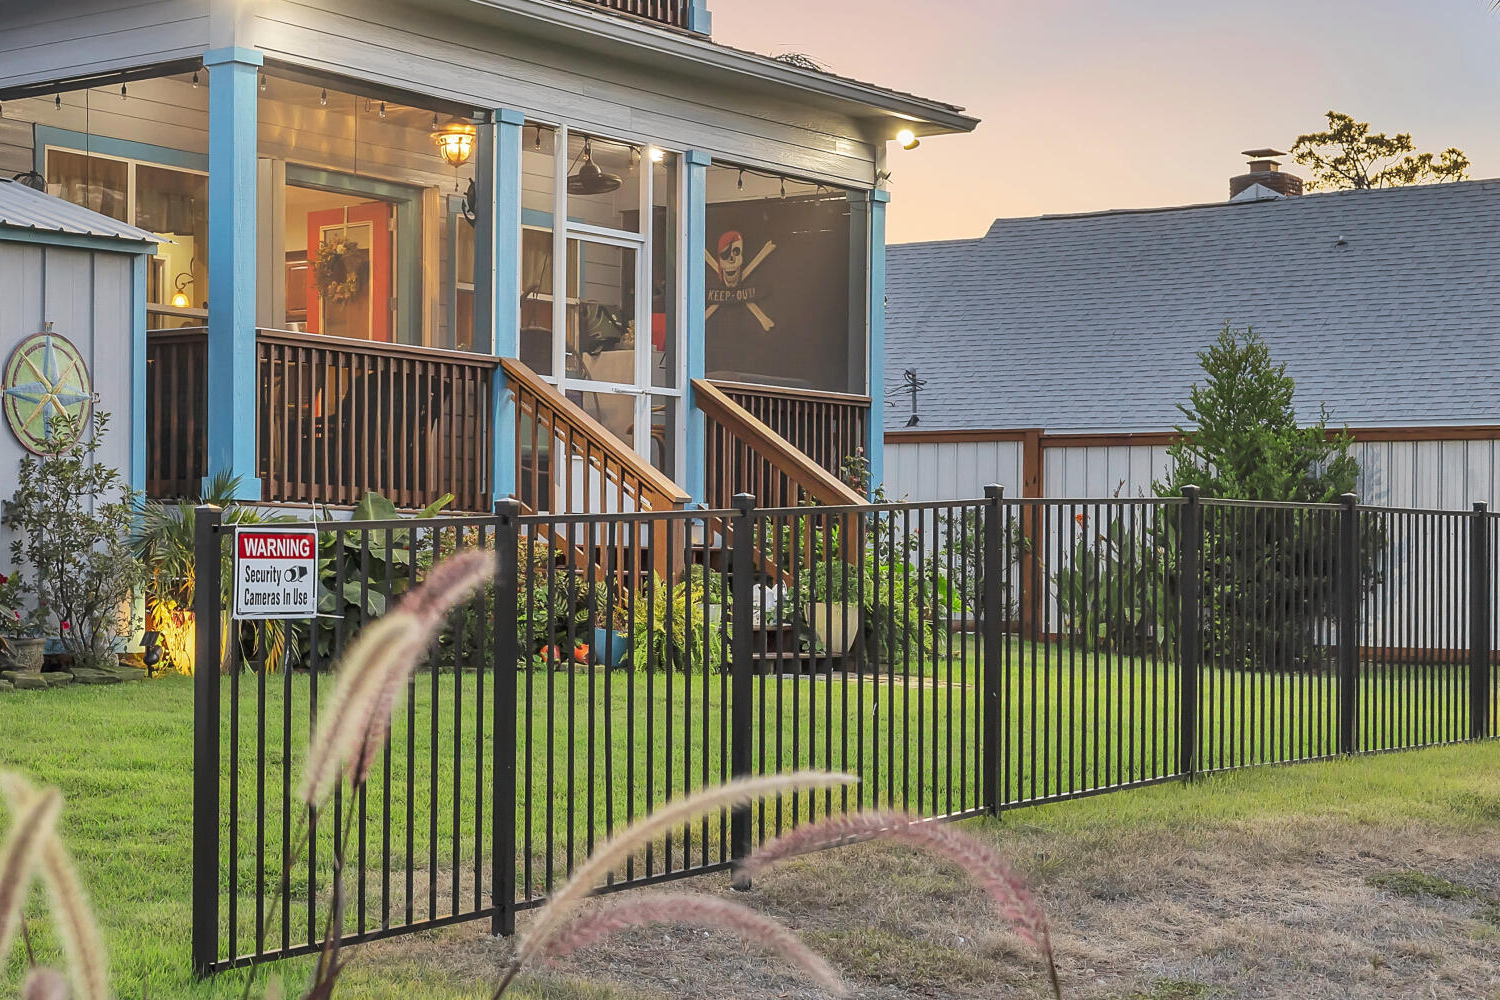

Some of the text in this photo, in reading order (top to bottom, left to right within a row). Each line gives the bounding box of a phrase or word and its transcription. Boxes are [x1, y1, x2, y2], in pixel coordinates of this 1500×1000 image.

[243, 537, 310, 557] WARNING
[245, 565, 282, 587] Security
[244, 588, 308, 606] Cameras In Use
